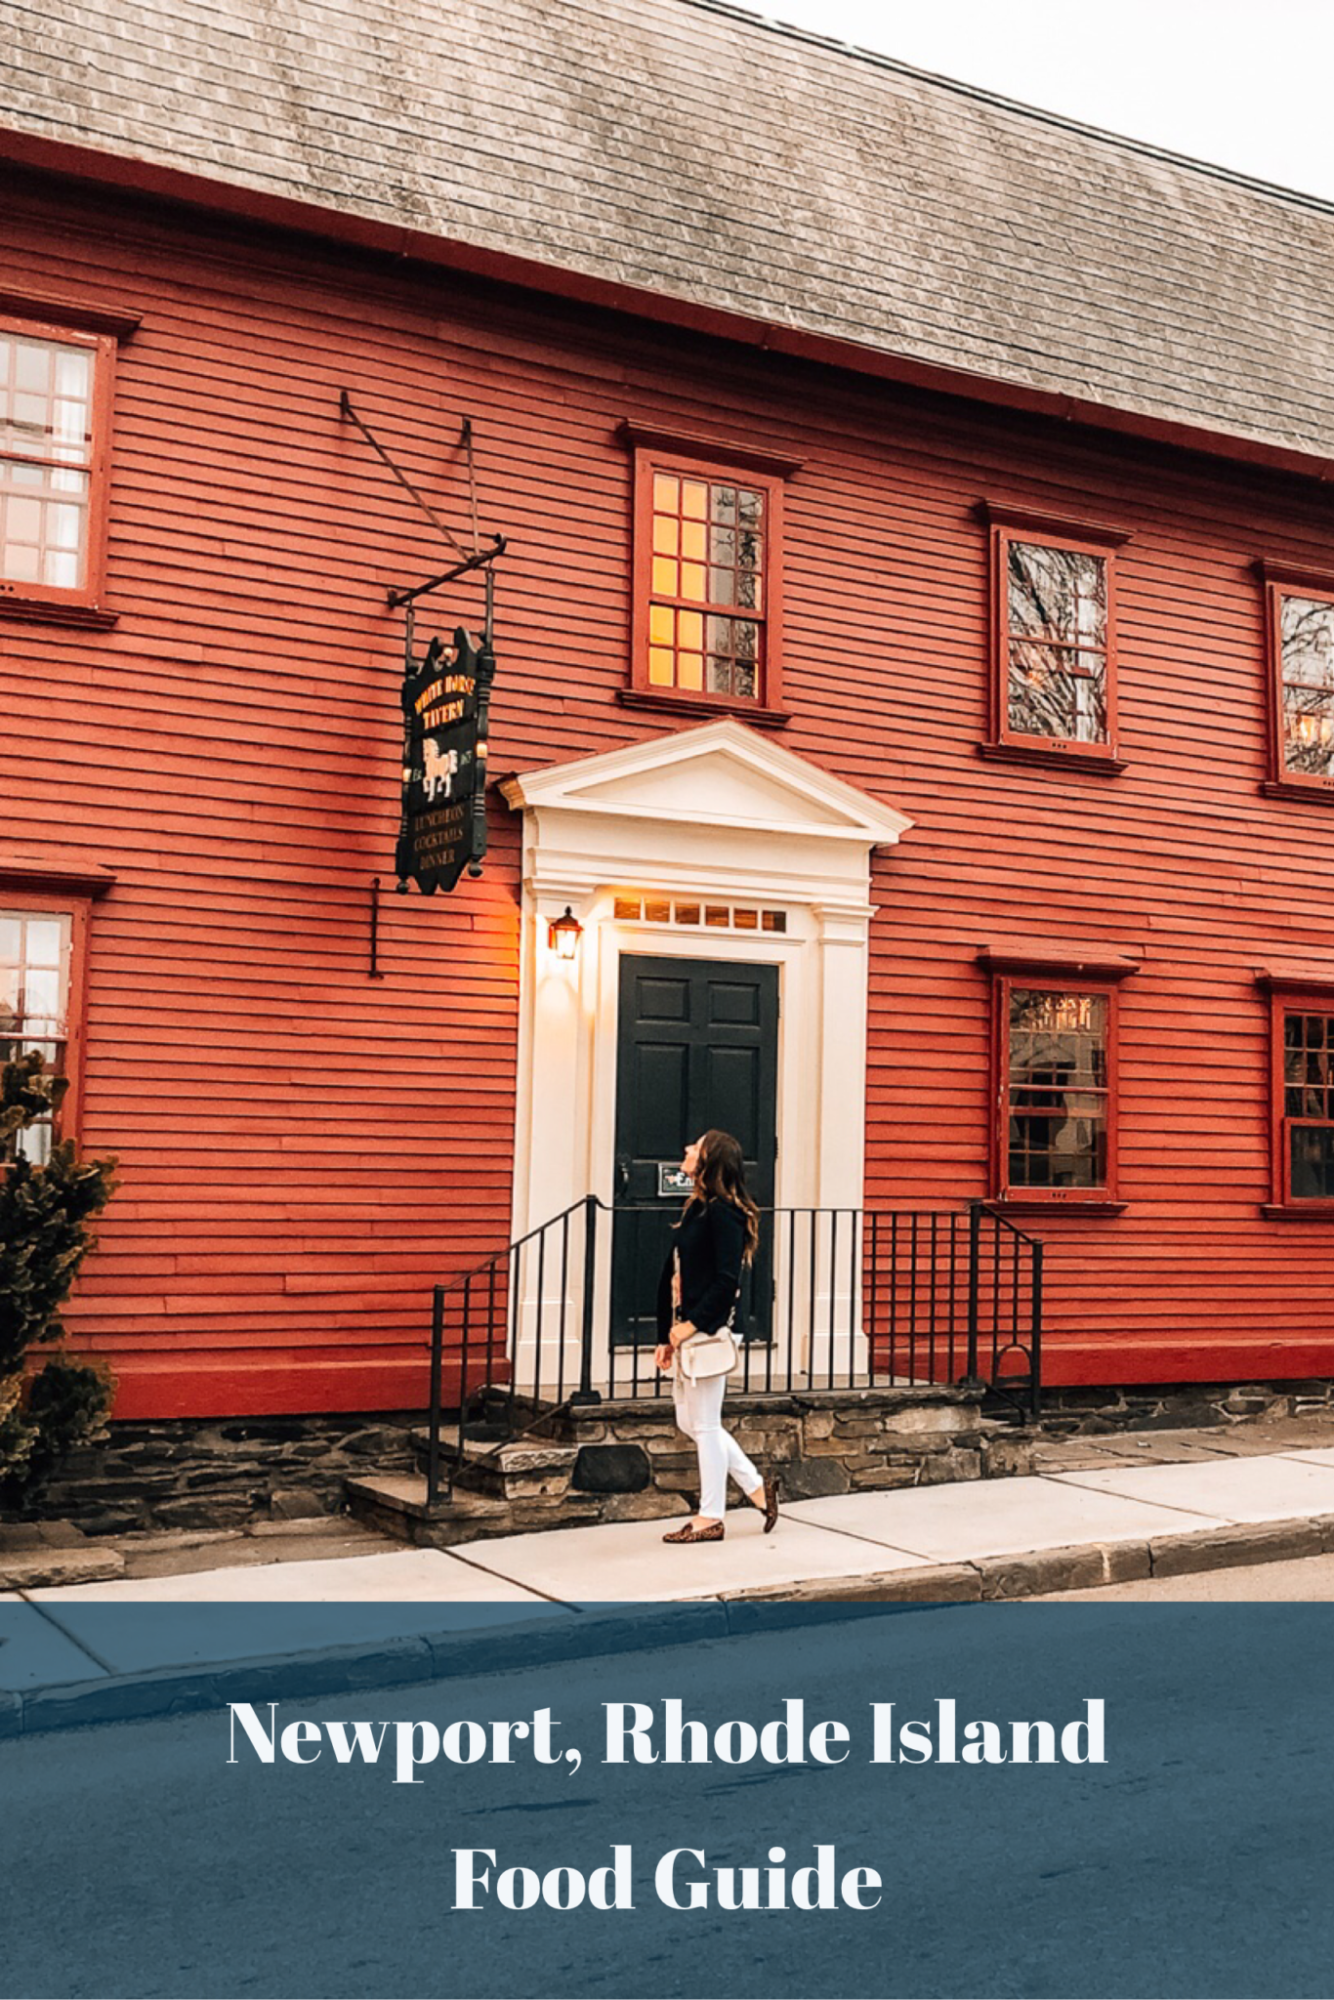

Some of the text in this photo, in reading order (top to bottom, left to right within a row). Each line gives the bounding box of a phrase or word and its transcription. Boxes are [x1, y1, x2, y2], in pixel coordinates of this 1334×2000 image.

[414, 674, 476, 715] WHITE HORSE
[422, 698, 465, 731] TAVERN
[414, 803, 464, 831] LUNCHEON
[413, 827, 464, 852] COCKTAILS
[419, 848, 455, 870] DINNER
